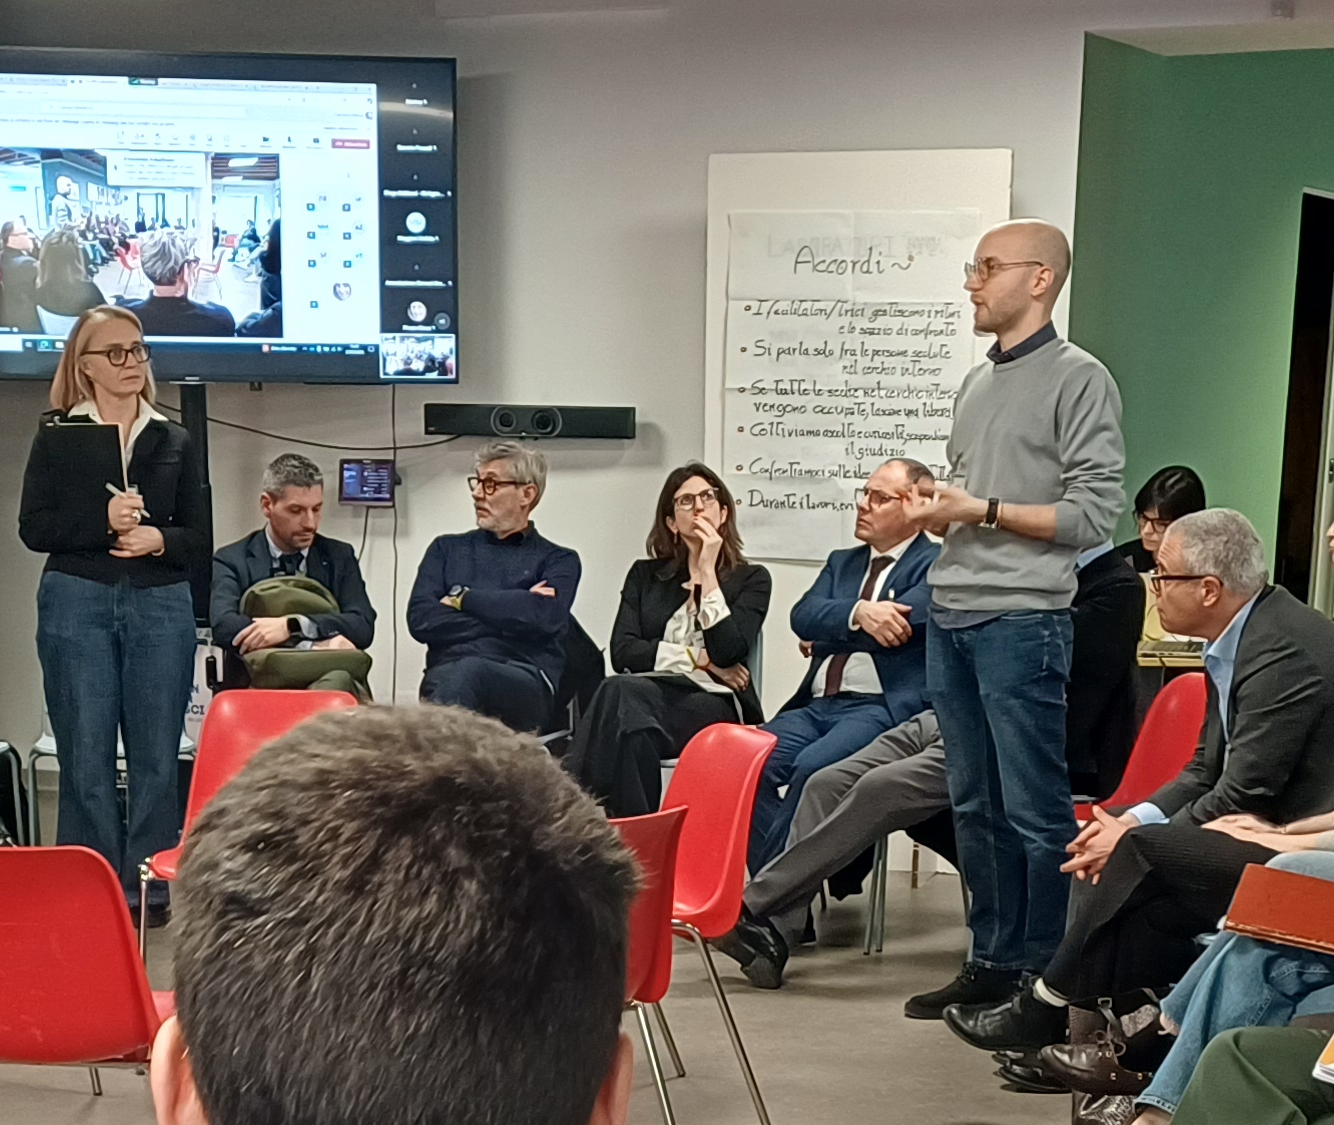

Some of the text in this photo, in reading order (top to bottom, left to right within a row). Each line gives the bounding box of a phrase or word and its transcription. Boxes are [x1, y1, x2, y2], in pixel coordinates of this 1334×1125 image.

[793, 245, 886, 276] Accordi
[753, 339, 772, 356] Si
[776, 340, 811, 362] parla
[812, 339, 835, 358] solo
[838, 340, 859, 360] fra
[750, 378, 768, 396] Se
[753, 401, 807, 418] vengono
[844, 440, 906, 461] il giudizio
[747, 488, 798, 510] Durante
